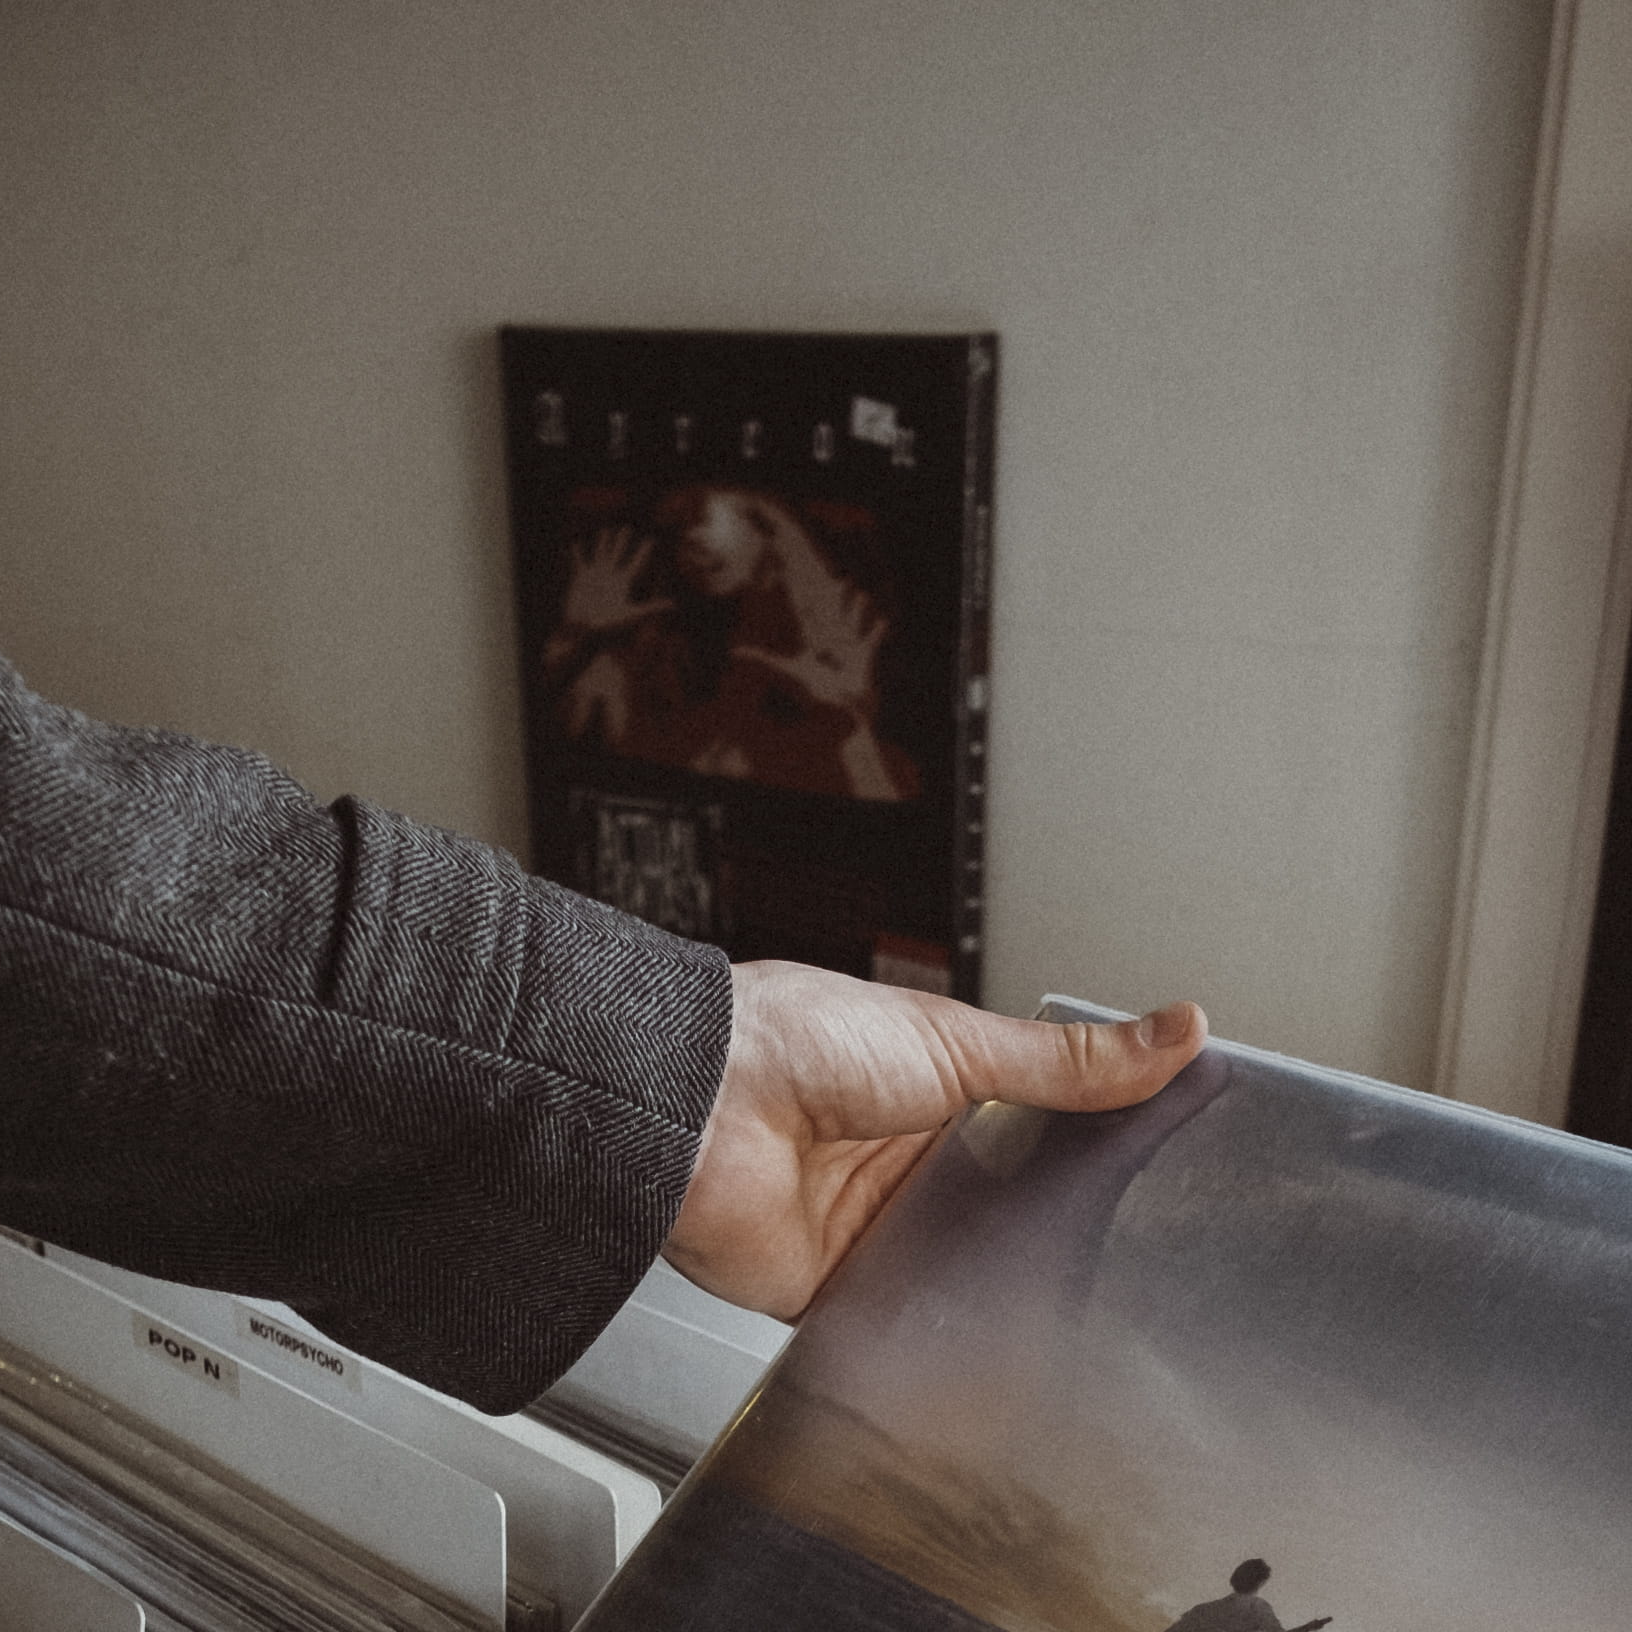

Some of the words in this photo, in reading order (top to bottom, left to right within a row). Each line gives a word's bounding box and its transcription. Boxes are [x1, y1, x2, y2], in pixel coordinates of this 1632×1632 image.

[148, 1327, 197, 1365] POP
[203, 1356, 222, 1381] N
[249, 1317, 345, 1377] MOTORPSYCHO
